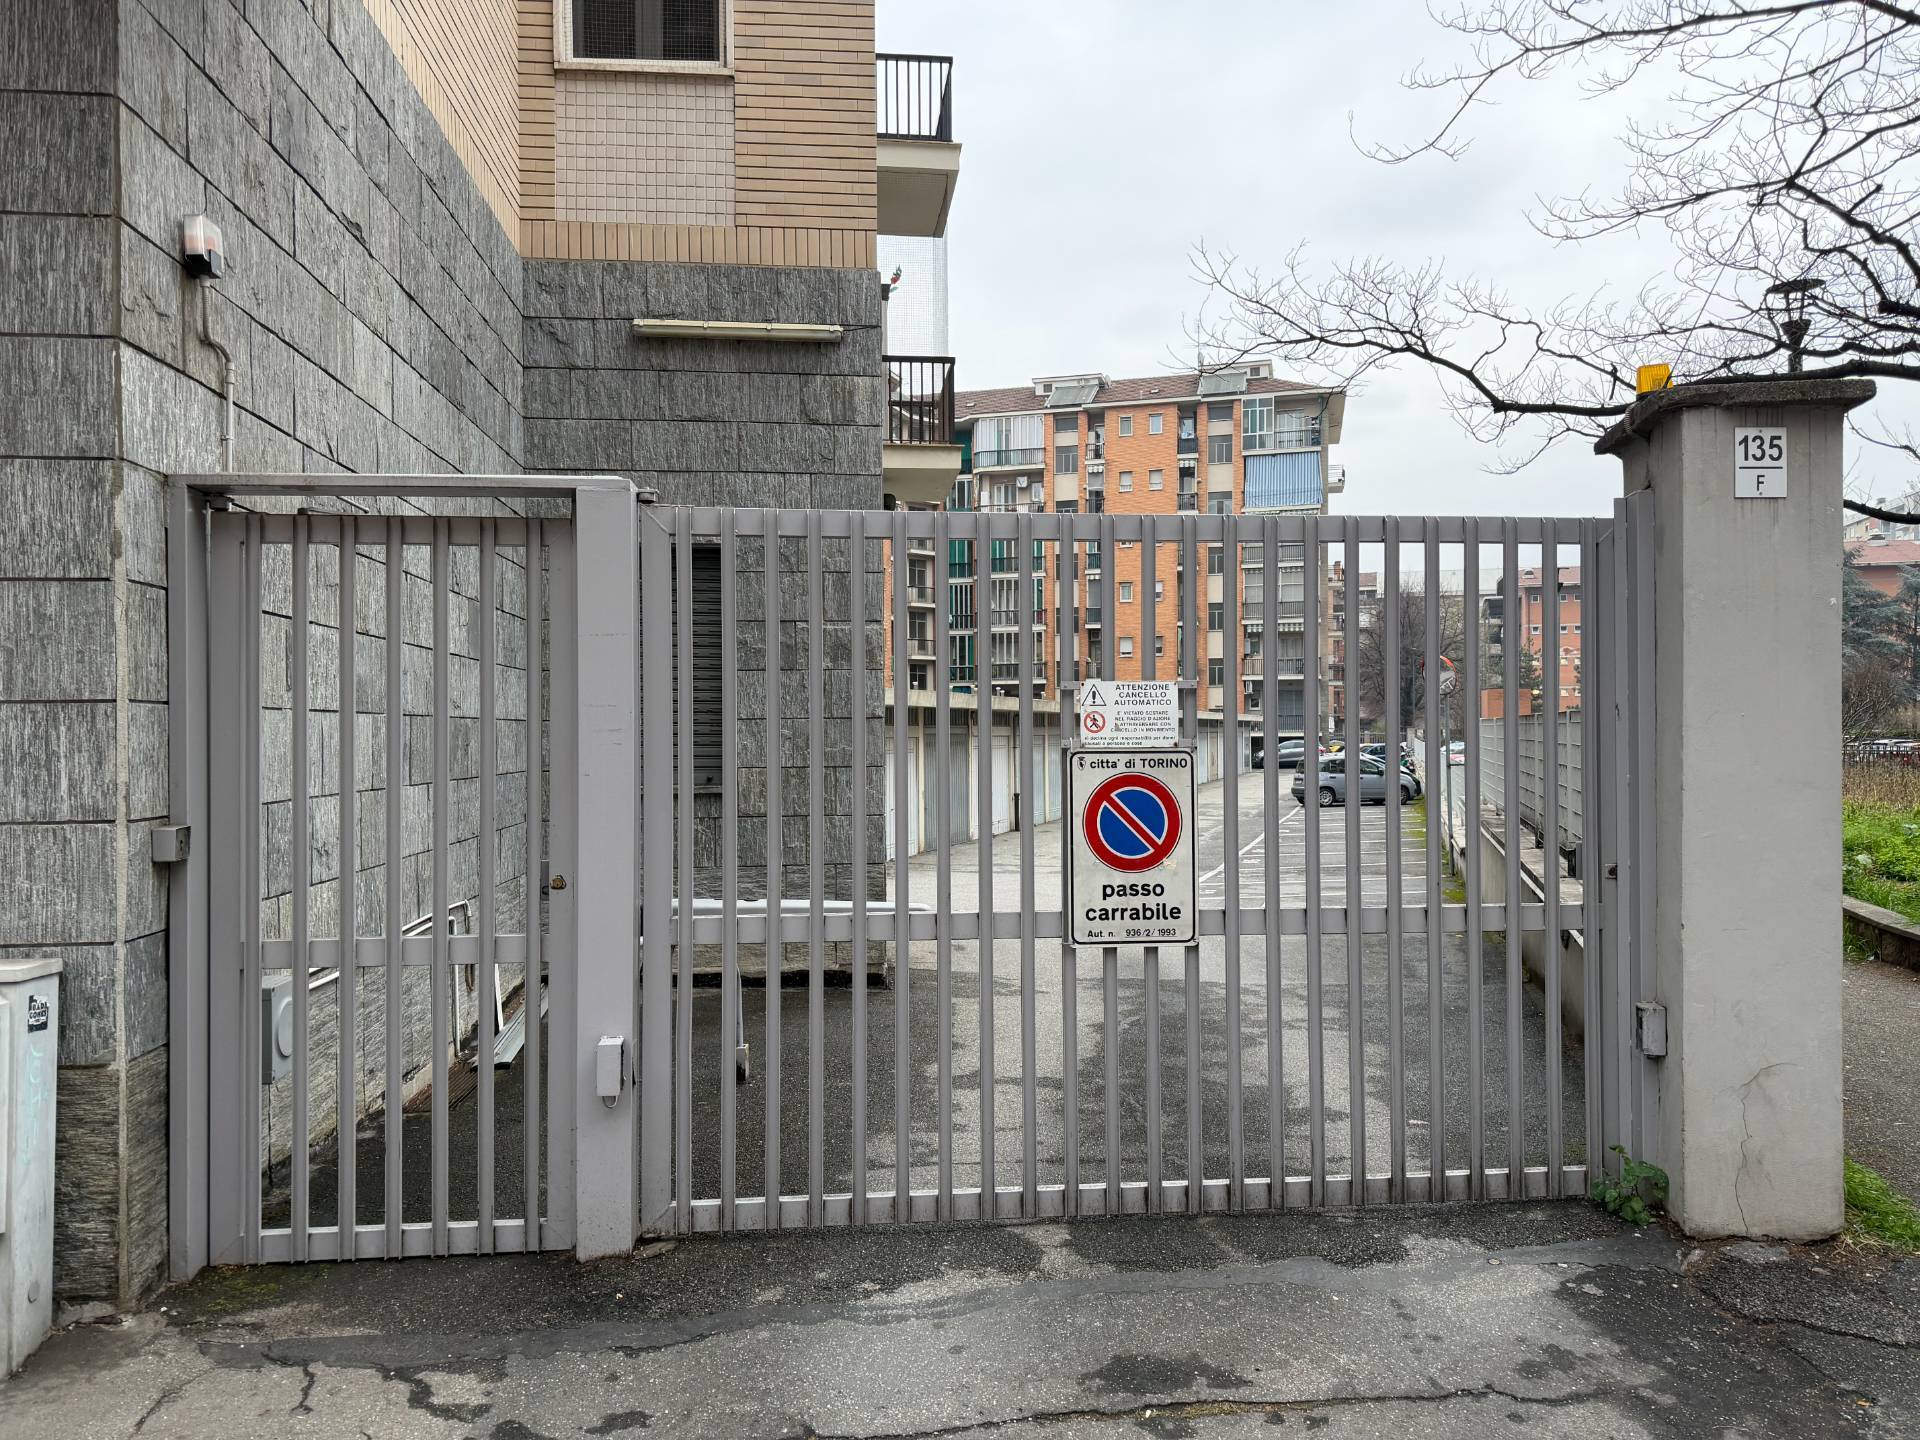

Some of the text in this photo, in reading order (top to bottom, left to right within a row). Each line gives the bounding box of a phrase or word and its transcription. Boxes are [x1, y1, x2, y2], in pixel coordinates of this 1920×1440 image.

[1738, 434, 1783, 462] 135
[1756, 475, 1765, 491] F
[1115, 683, 1170, 691] ATTENZIONE
[1118, 691, 1167, 699] CANCELLO
[1089, 758, 1188, 769] citta' di TORINO
[1102, 883, 1165, 901] passo
[1085, 902, 1182, 921] carrabile
[1087, 929, 1105, 938] Aut.
